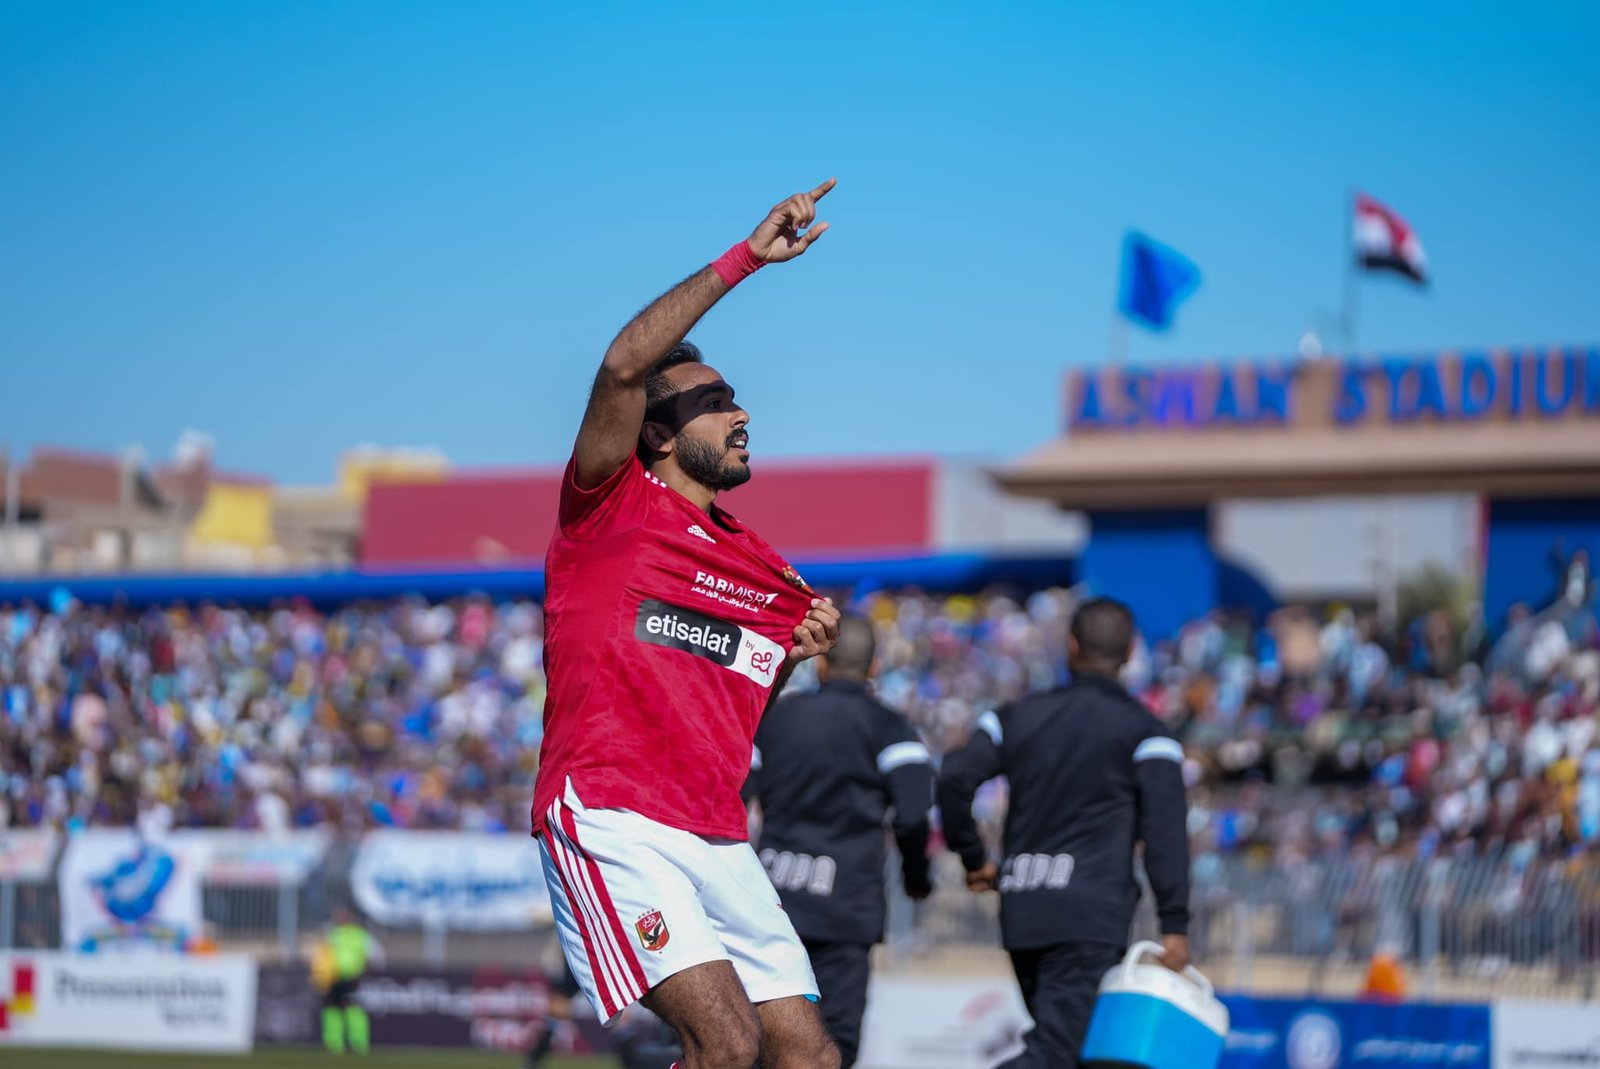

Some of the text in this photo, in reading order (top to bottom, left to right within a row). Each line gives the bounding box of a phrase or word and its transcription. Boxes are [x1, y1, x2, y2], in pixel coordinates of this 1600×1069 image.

[1073, 366, 1287, 424] ASWAN
[646, 615, 731, 655] etisalat
[745, 640, 755, 651] by
